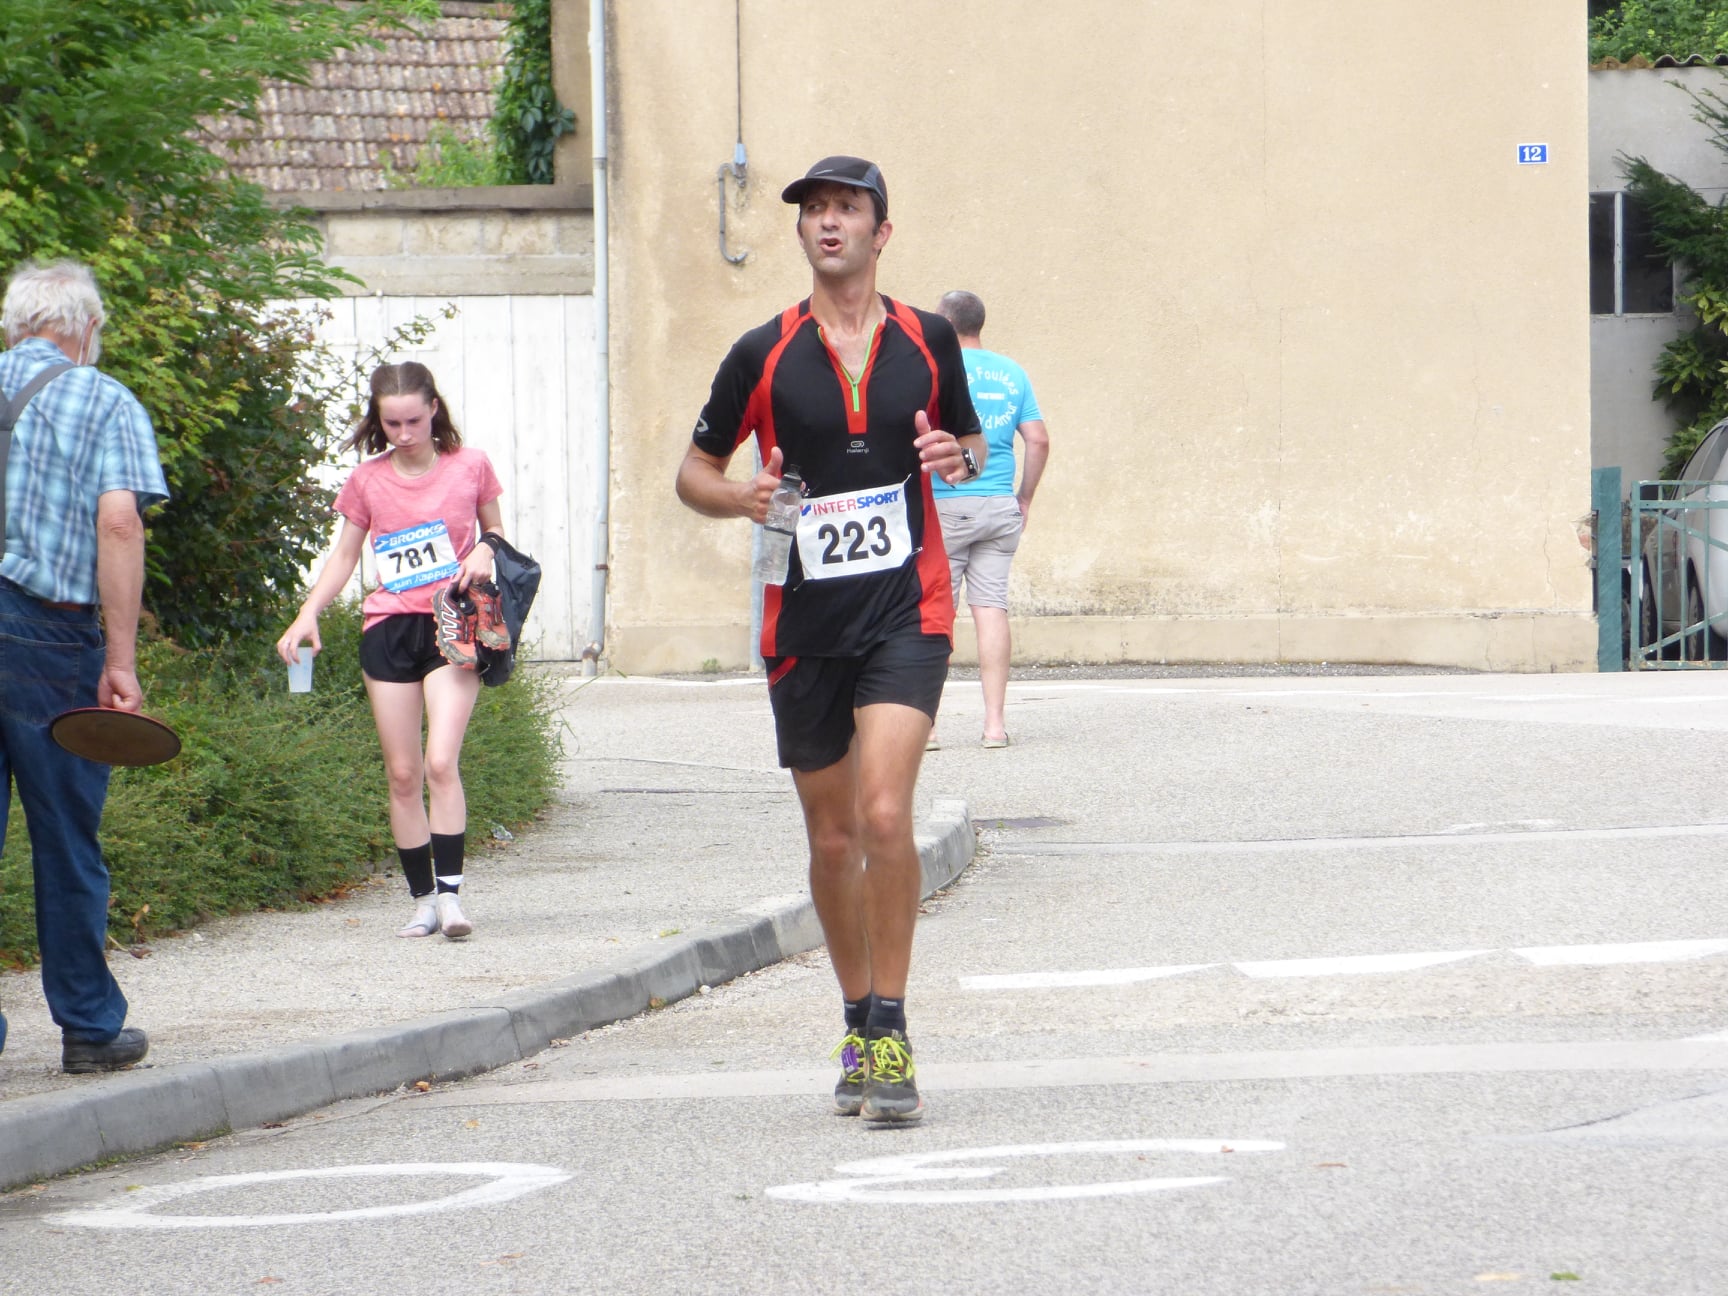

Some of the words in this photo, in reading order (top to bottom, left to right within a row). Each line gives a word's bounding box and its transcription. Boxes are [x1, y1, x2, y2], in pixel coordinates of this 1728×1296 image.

[1523, 146, 1542, 161] 12
[813, 490, 899, 516] INTERSPORT
[389, 523, 446, 546] BROOKS
[818, 515, 892, 565] 223
[388, 541, 438, 574] 781
